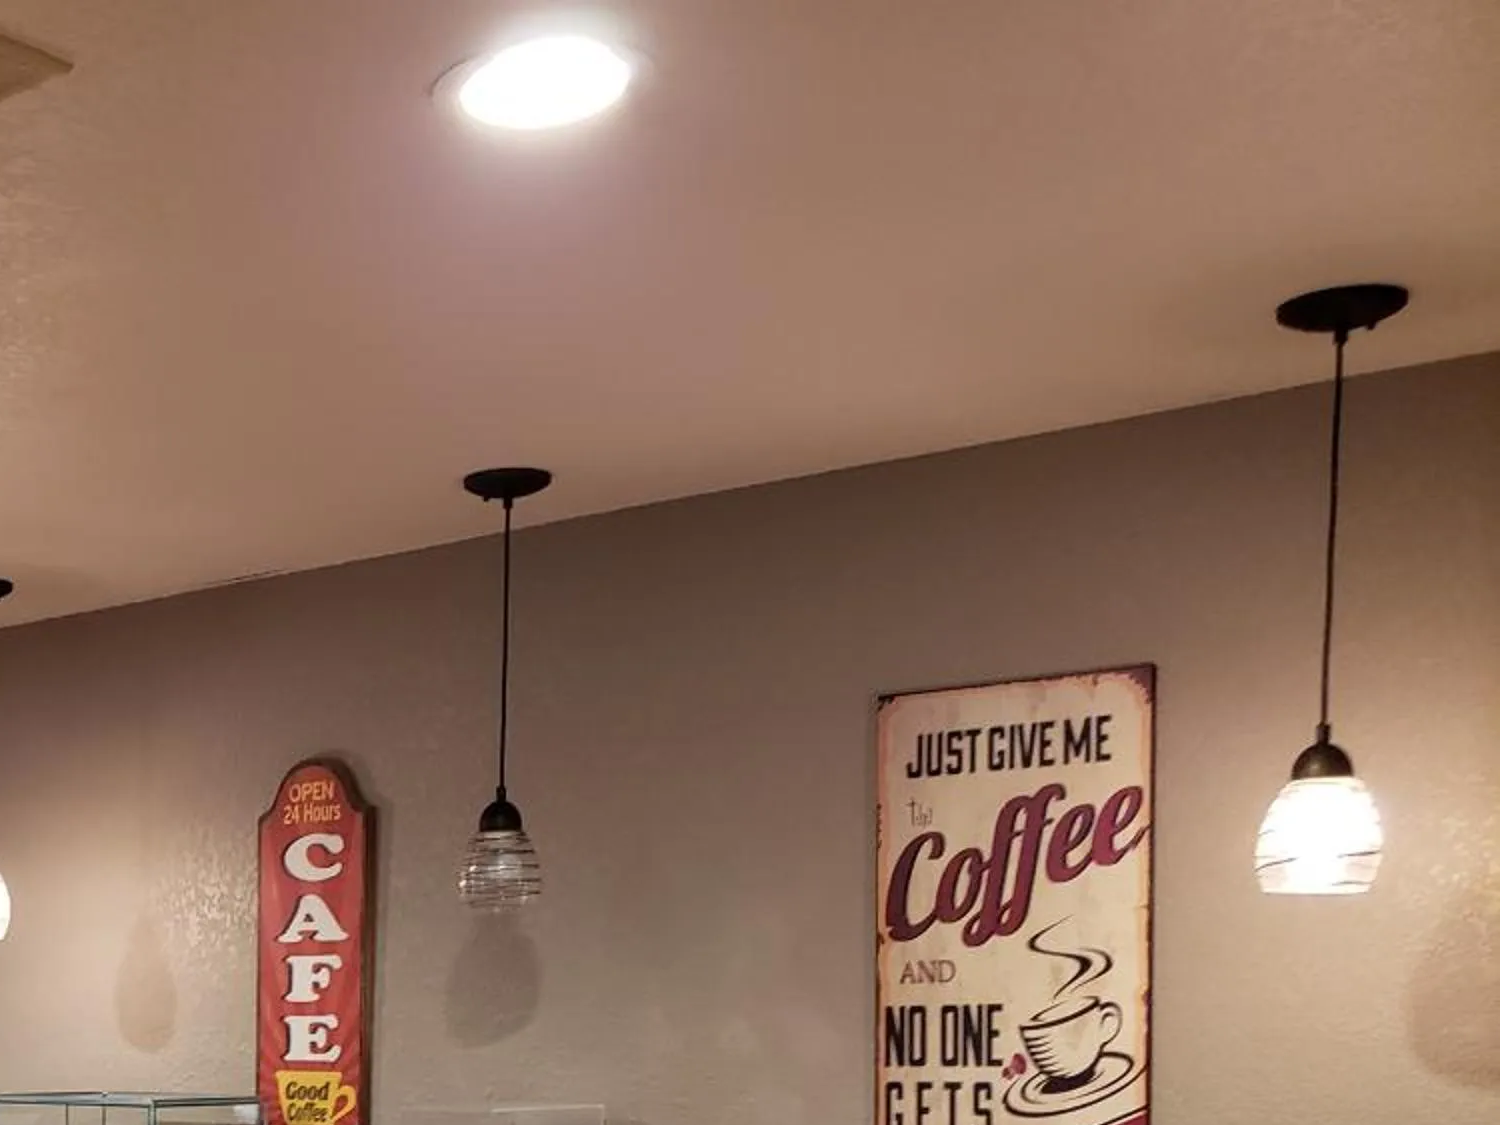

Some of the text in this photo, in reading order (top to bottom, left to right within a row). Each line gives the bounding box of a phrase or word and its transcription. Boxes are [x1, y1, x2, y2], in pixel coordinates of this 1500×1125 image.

[906, 714, 1113, 779] JUST GIVE ME
[289, 780, 334, 803] OPEN
[283, 801, 341, 825] 24 Hours
[886, 783, 1150, 947] Coffee
[277, 833, 349, 1062] CAFE
[900, 959, 956, 985] AND
[884, 1003, 1004, 1067] NO ONE
[285, 1081, 330, 1101] Good
[286, 1101, 329, 1124] Coffee
